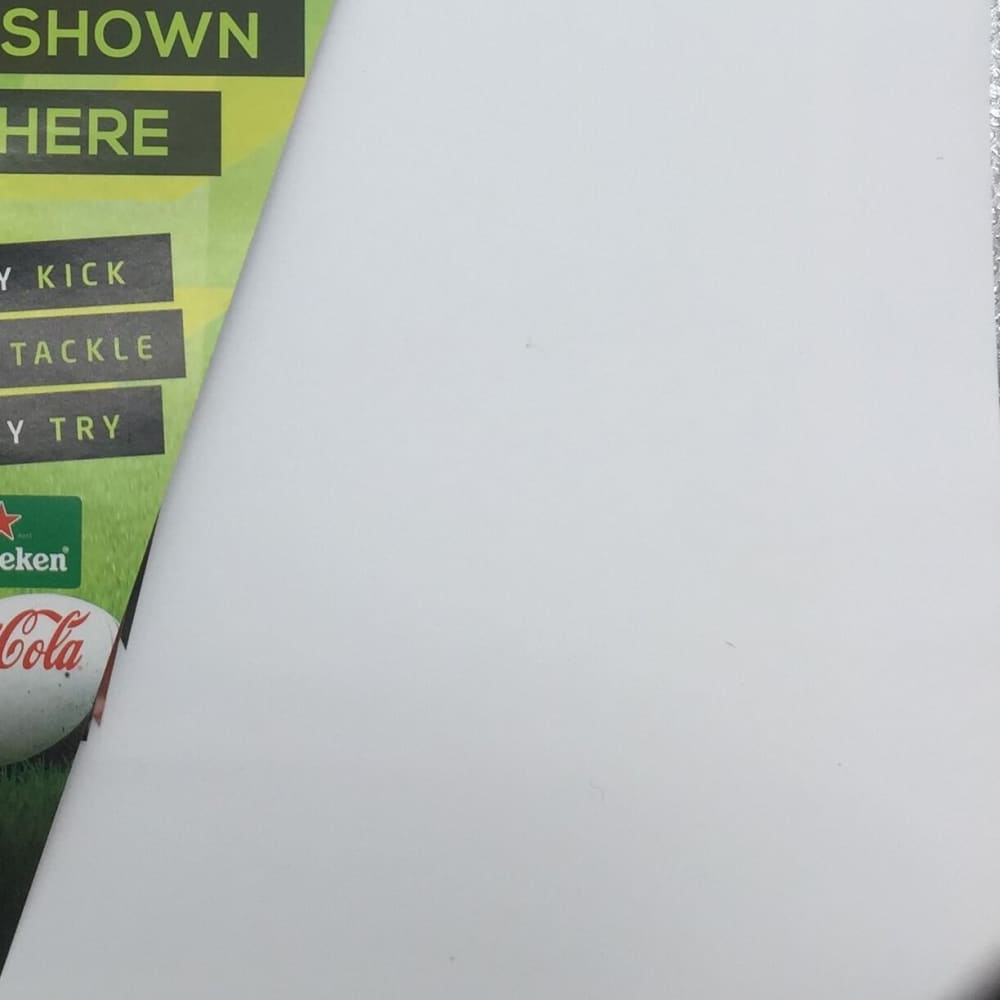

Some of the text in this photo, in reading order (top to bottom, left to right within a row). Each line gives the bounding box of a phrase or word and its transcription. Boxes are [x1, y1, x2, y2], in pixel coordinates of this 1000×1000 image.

[1, 6, 259, 60] SHOWN
[37, 260, 126, 289] KICK
[10, 334, 153, 367] TACKLE
[49, 414, 120, 441] TRY
